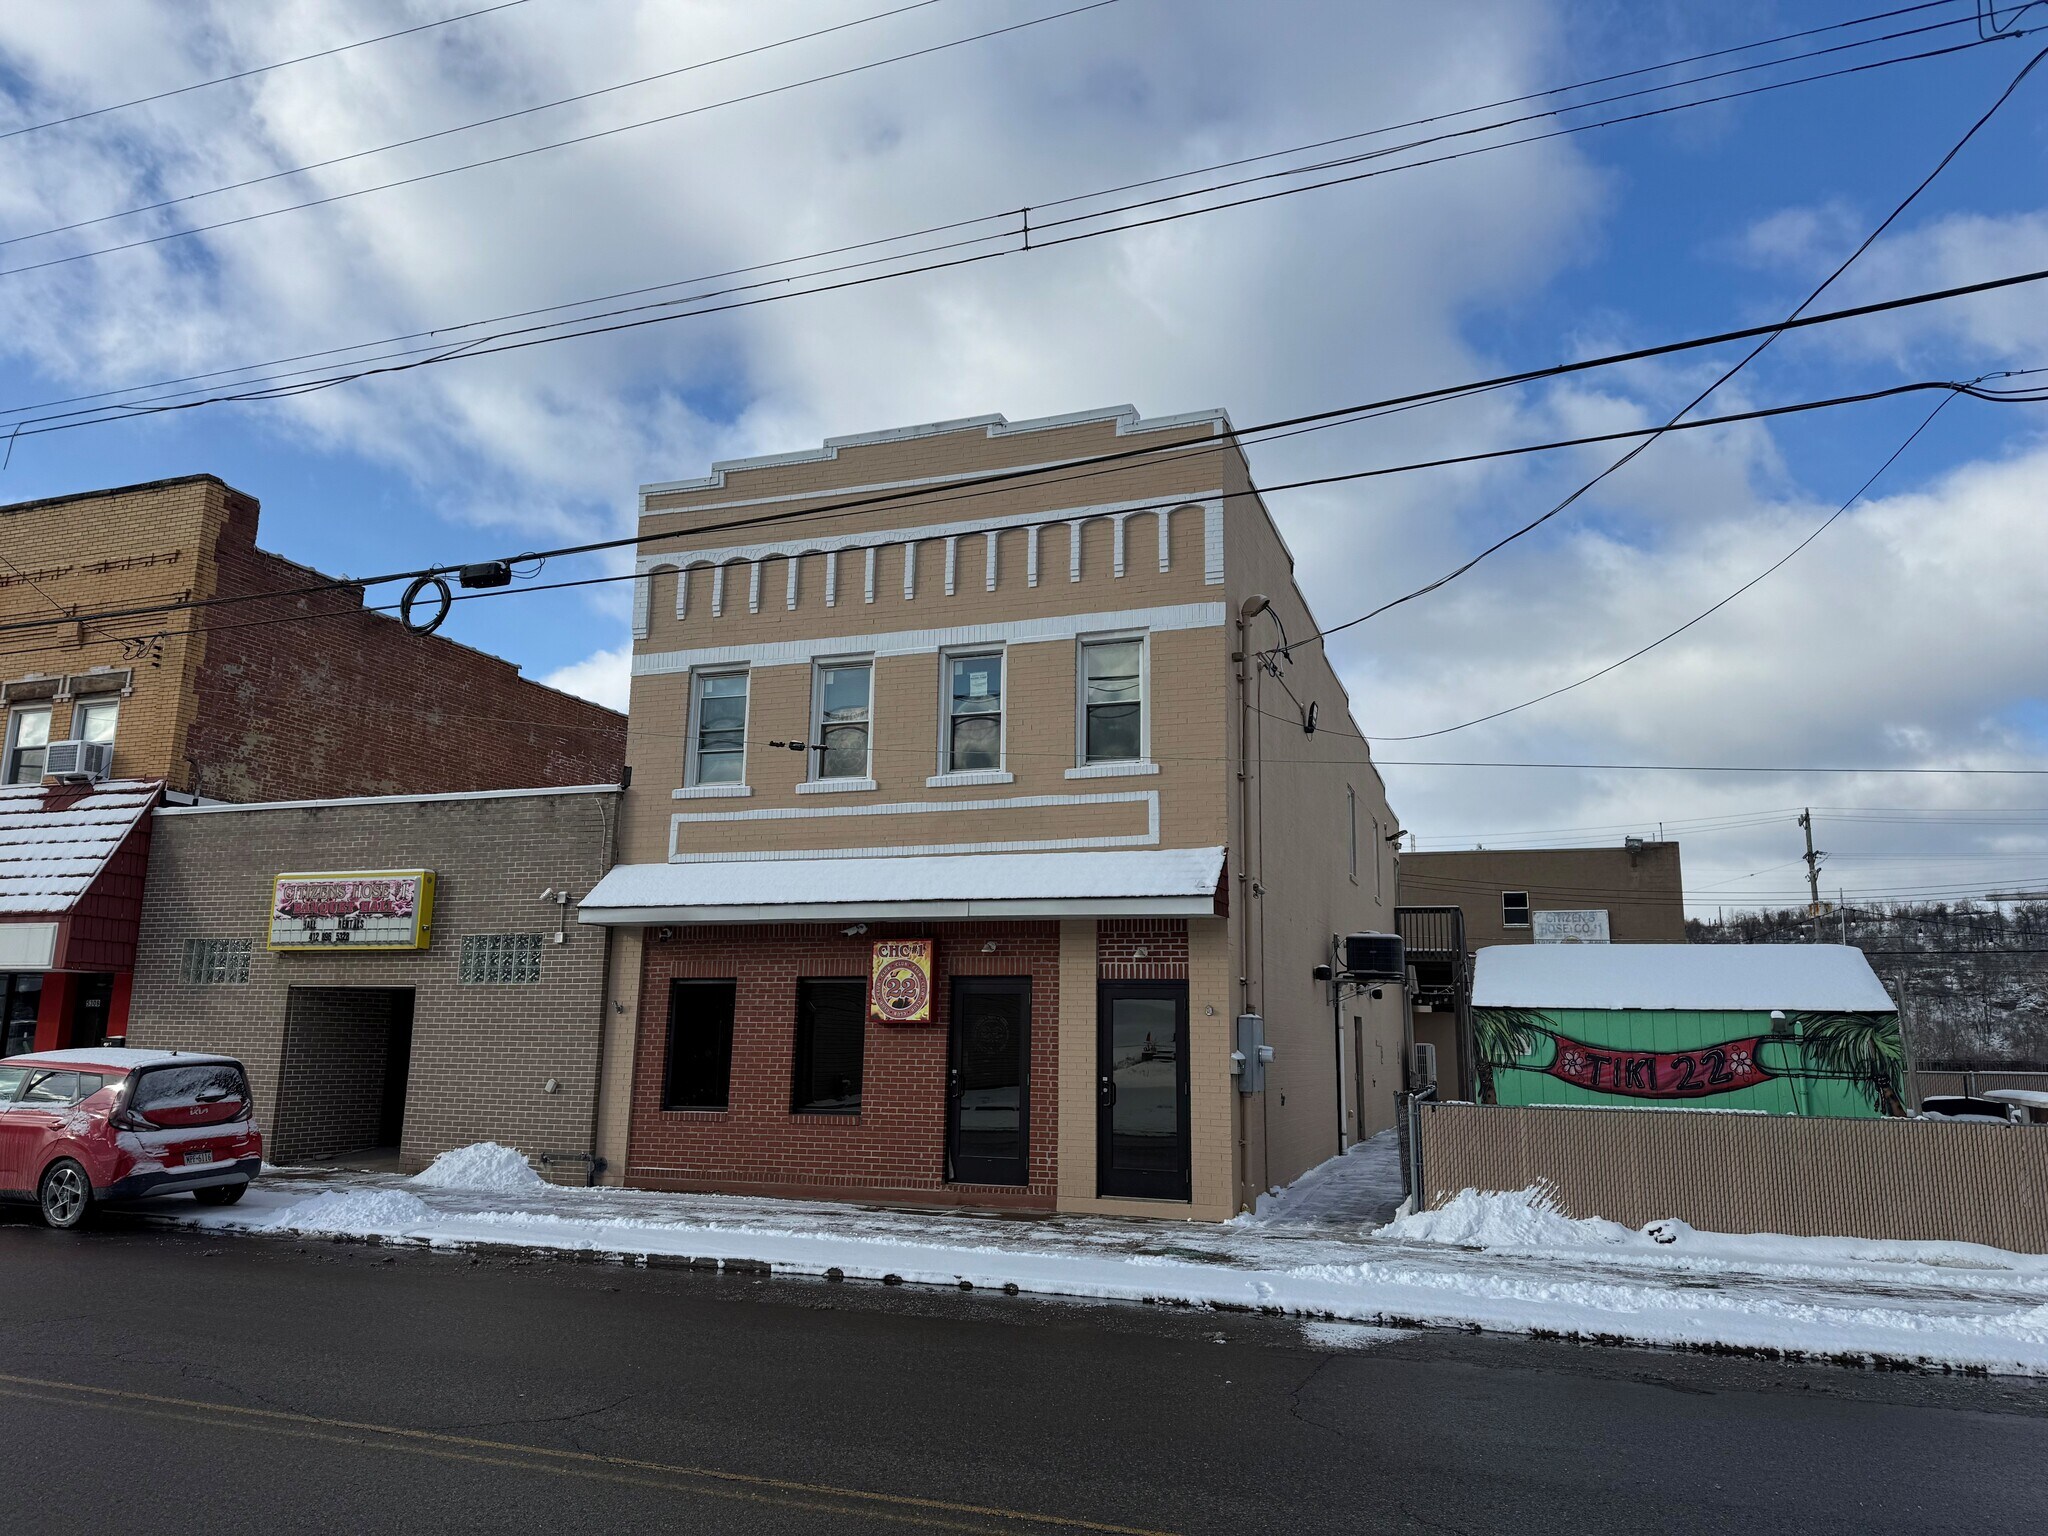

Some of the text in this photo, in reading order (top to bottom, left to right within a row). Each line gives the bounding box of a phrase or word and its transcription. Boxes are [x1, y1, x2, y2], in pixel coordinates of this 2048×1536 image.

[284, 885, 346, 900] CITIZENS
[352, 883, 391, 898] HOSE
[293, 900, 395, 914] BANQUET HALL
[338, 919, 364, 929] RENTALS
[1539, 924, 1569, 933] HOSE
[309, 932, 319, 941] 412
[886, 978, 917, 998] 22
[1586, 1049, 1733, 1091] TIKI 22
